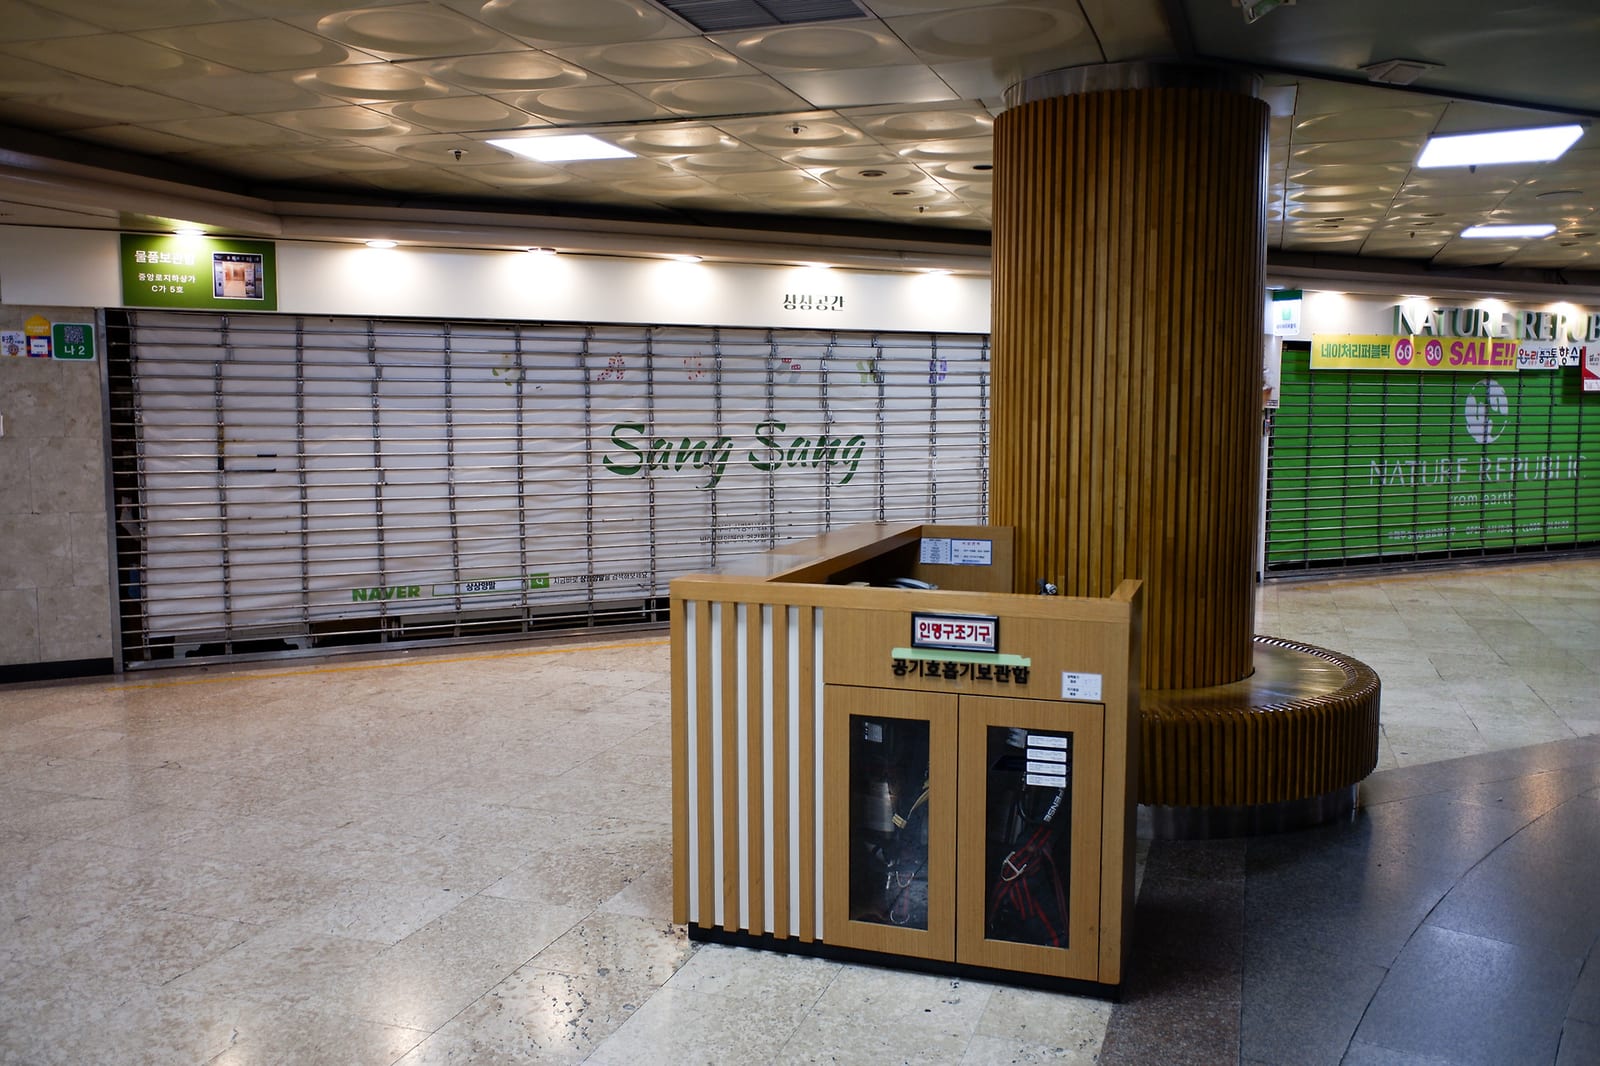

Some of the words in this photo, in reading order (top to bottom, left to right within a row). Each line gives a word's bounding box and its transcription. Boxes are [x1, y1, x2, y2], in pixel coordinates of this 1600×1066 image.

[138, 273, 196, 284] 중앙로지하상가
[152, 285, 166, 294] C가
[170, 286, 184, 294] 5호
[1394, 305, 1516, 337] NATURE
[78, 346, 85, 355] 2
[1321, 342, 1391, 360] 네이처리퍼블릭
[1396, 344, 1412, 360] 60
[1426, 345, 1442, 361] 30
[1449, 342, 1516, 366] SALE!!
[603, 420, 733, 488] Sang
[748, 419, 866, 485] Sang
[1369, 458, 1469, 487] NATURE
[352, 586, 420, 602] NAVER
[920, 622, 990, 642] 인명구조기구
[892, 658, 1030, 684] 공기호흡기보관함
